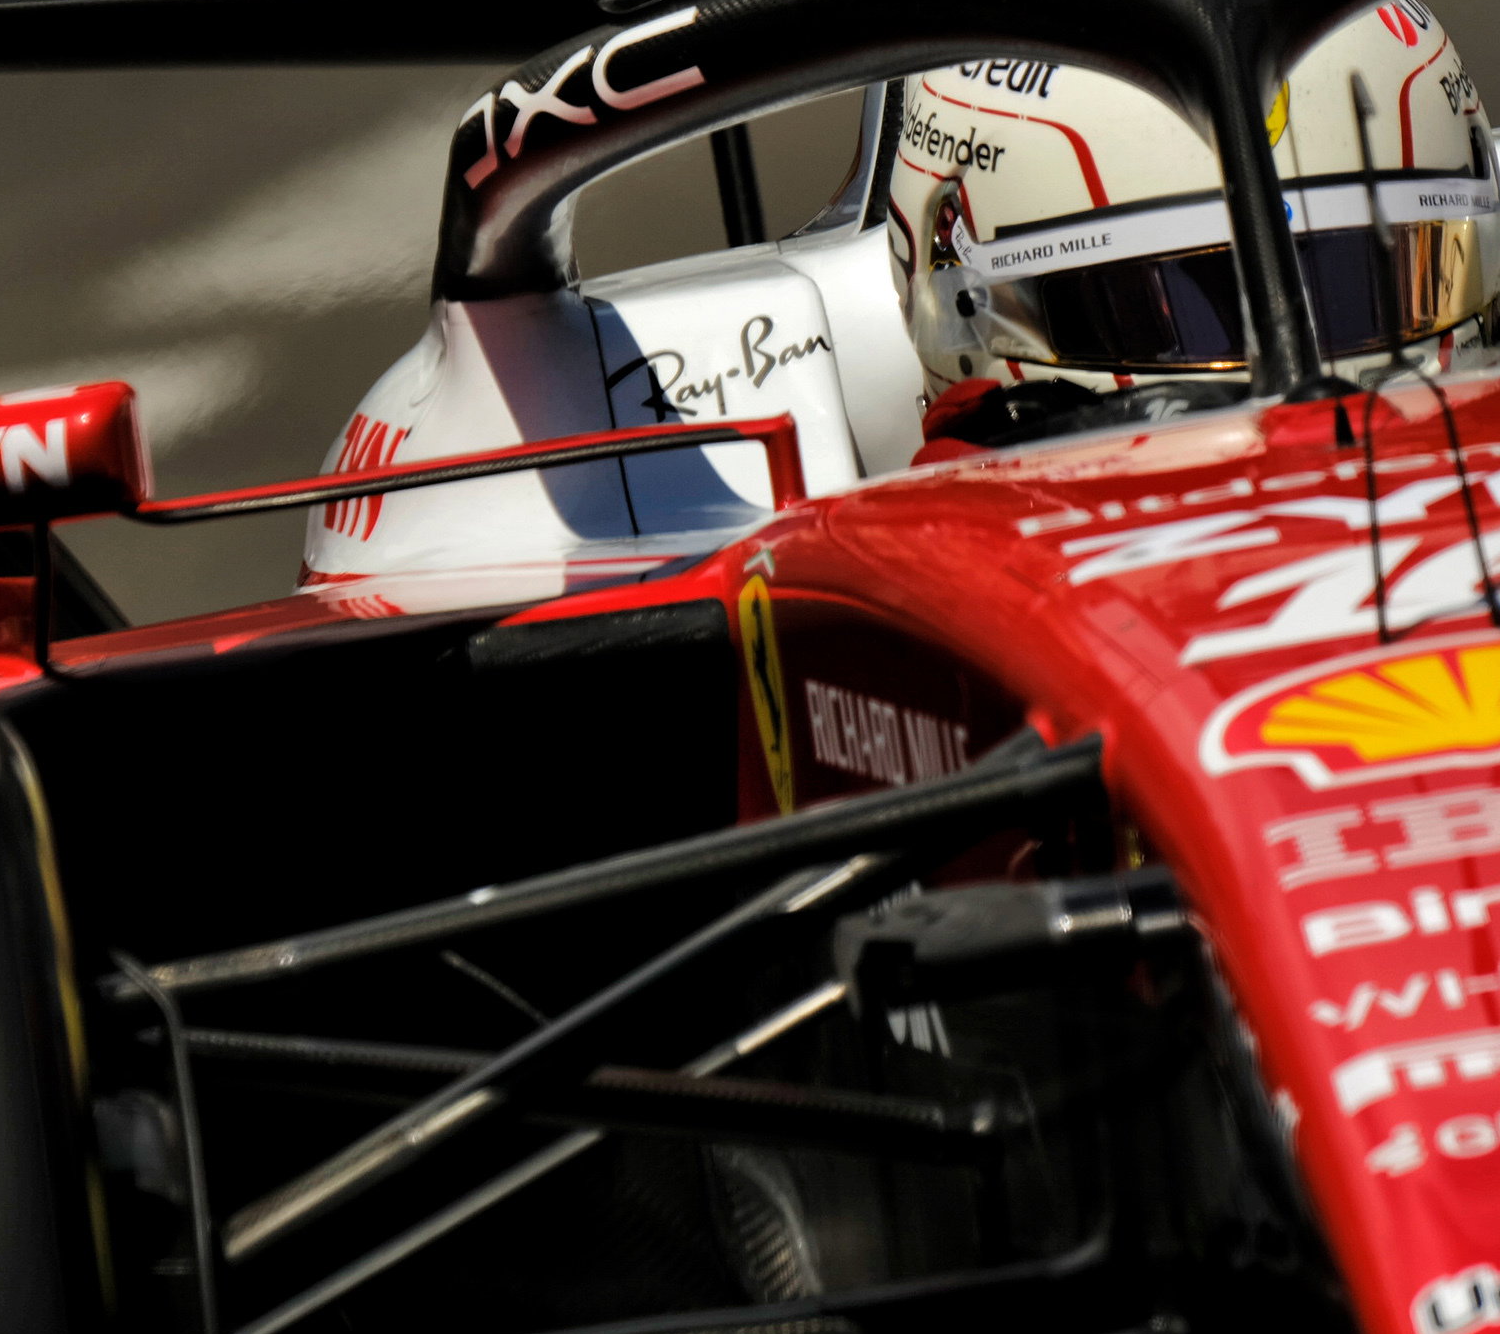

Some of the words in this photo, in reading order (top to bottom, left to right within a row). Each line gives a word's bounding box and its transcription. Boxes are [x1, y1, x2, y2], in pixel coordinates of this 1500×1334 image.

[456, 5, 707, 191] DXC
[1419, 193, 1470, 208] RICHARD
[991, 243, 1055, 271] RICHARD
[1058, 232, 1113, 254] MILLE
[608, 315, 834, 423] Ray-Ban
